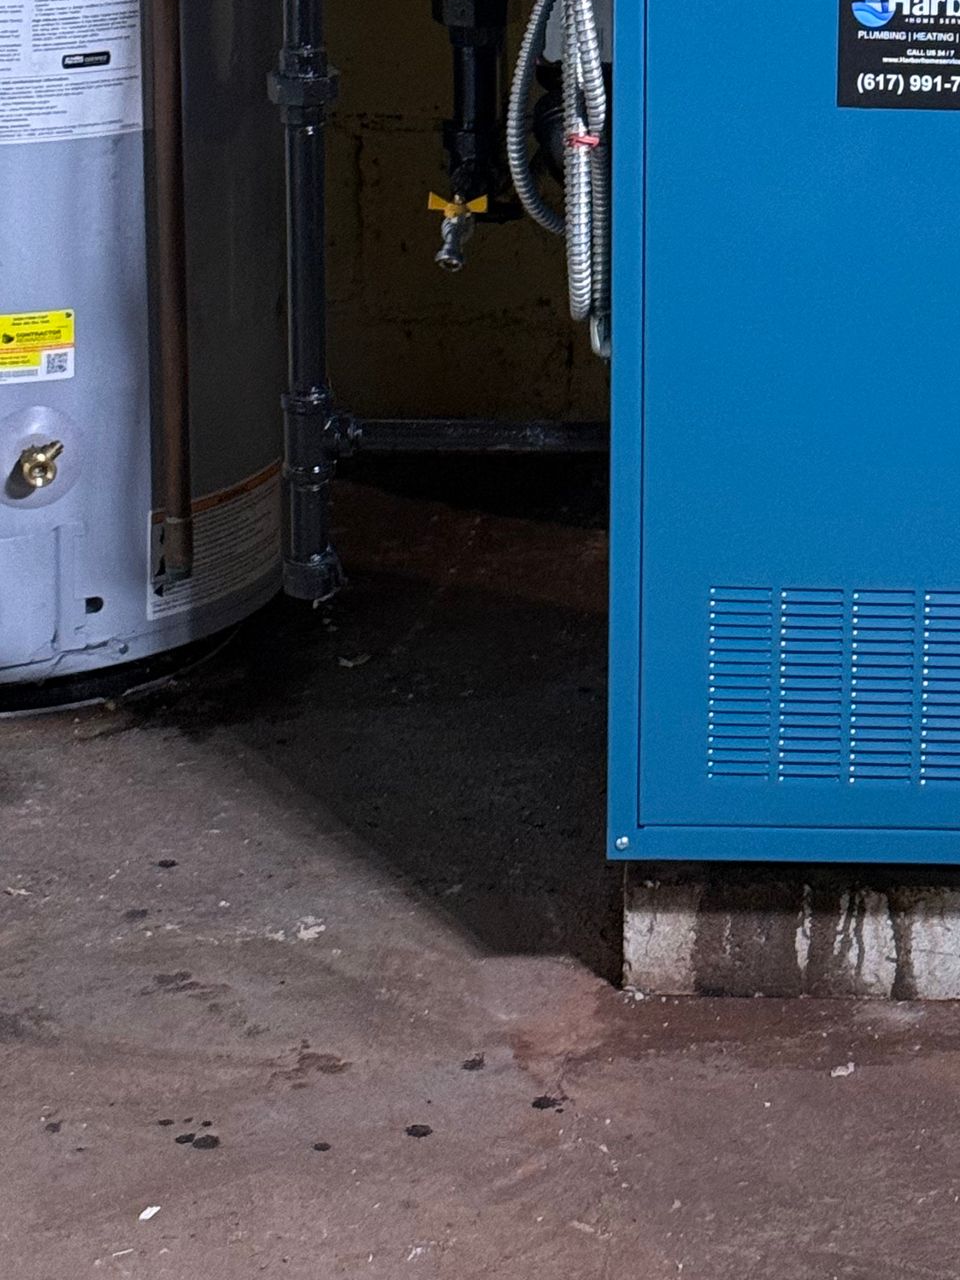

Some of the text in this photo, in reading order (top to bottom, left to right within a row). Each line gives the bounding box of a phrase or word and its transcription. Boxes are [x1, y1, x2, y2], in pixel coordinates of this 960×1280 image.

[858, 30, 906, 40] PLUMBING
[913, 32, 954, 41] HEATING
[857, 73, 904, 95] (617)
